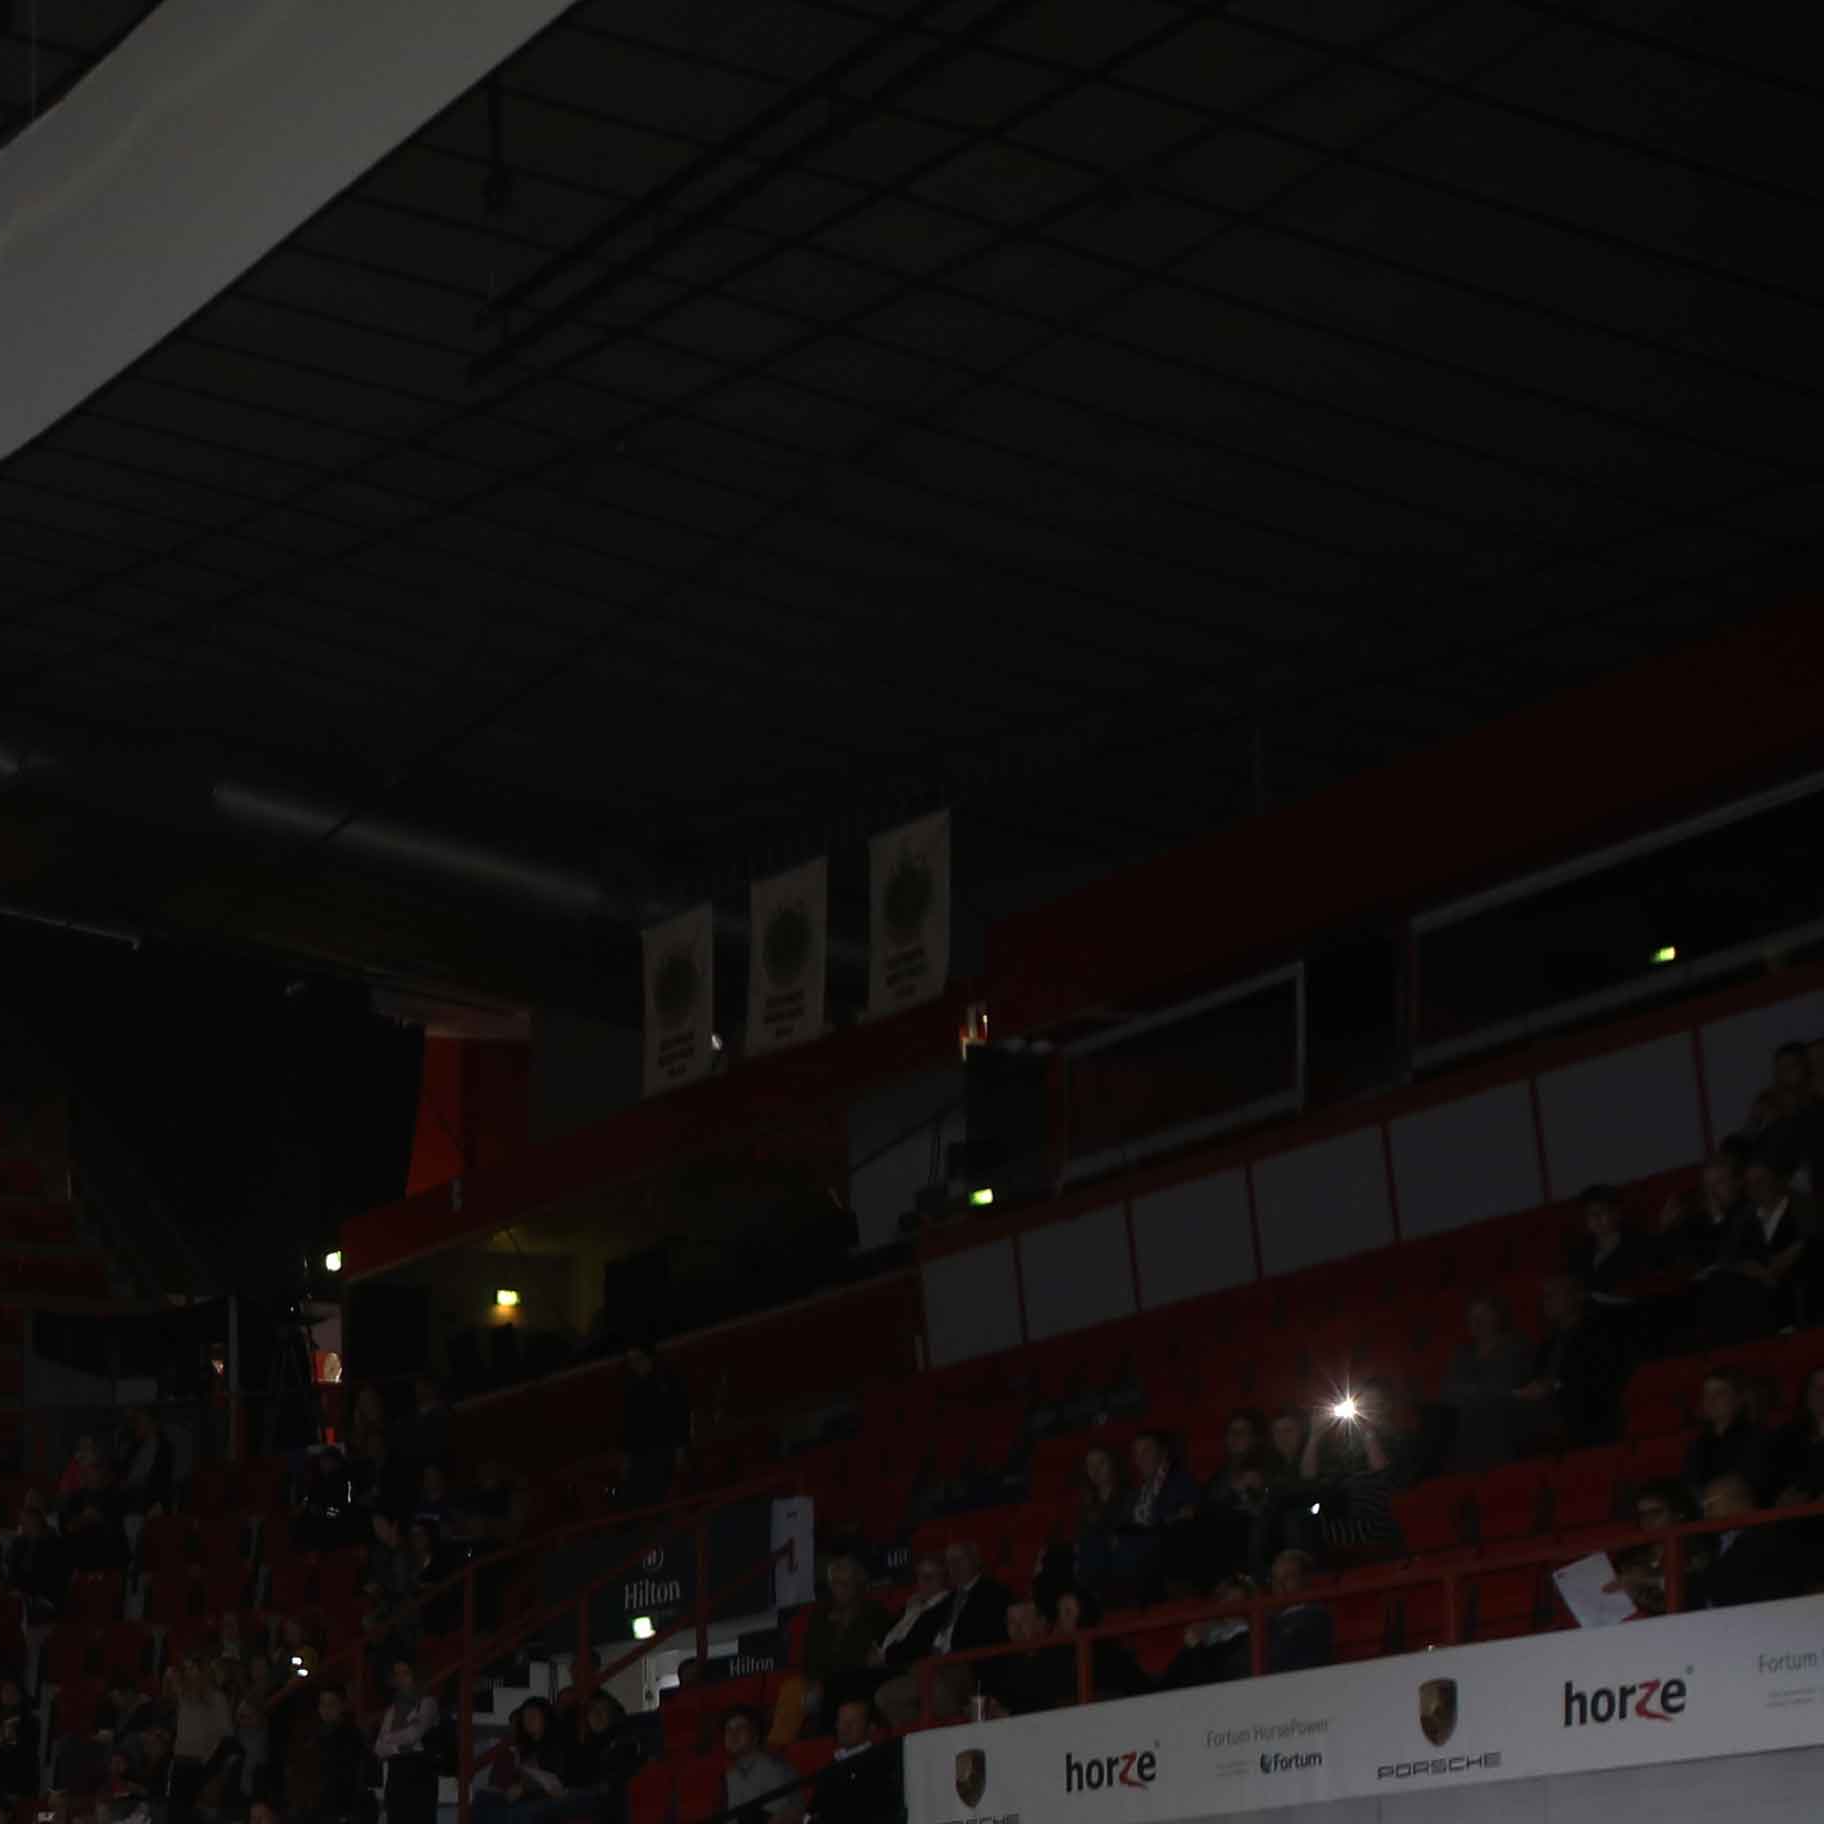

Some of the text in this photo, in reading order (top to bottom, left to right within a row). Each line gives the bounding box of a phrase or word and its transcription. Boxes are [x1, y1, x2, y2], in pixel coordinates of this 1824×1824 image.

[624, 1578, 681, 1610] Hilton
[1563, 1676, 1688, 1728] horze
[1065, 1749, 1158, 1793] horze
[1272, 1751, 1323, 1771] Fortum
[1376, 1751, 1502, 1781] PORSCHE
